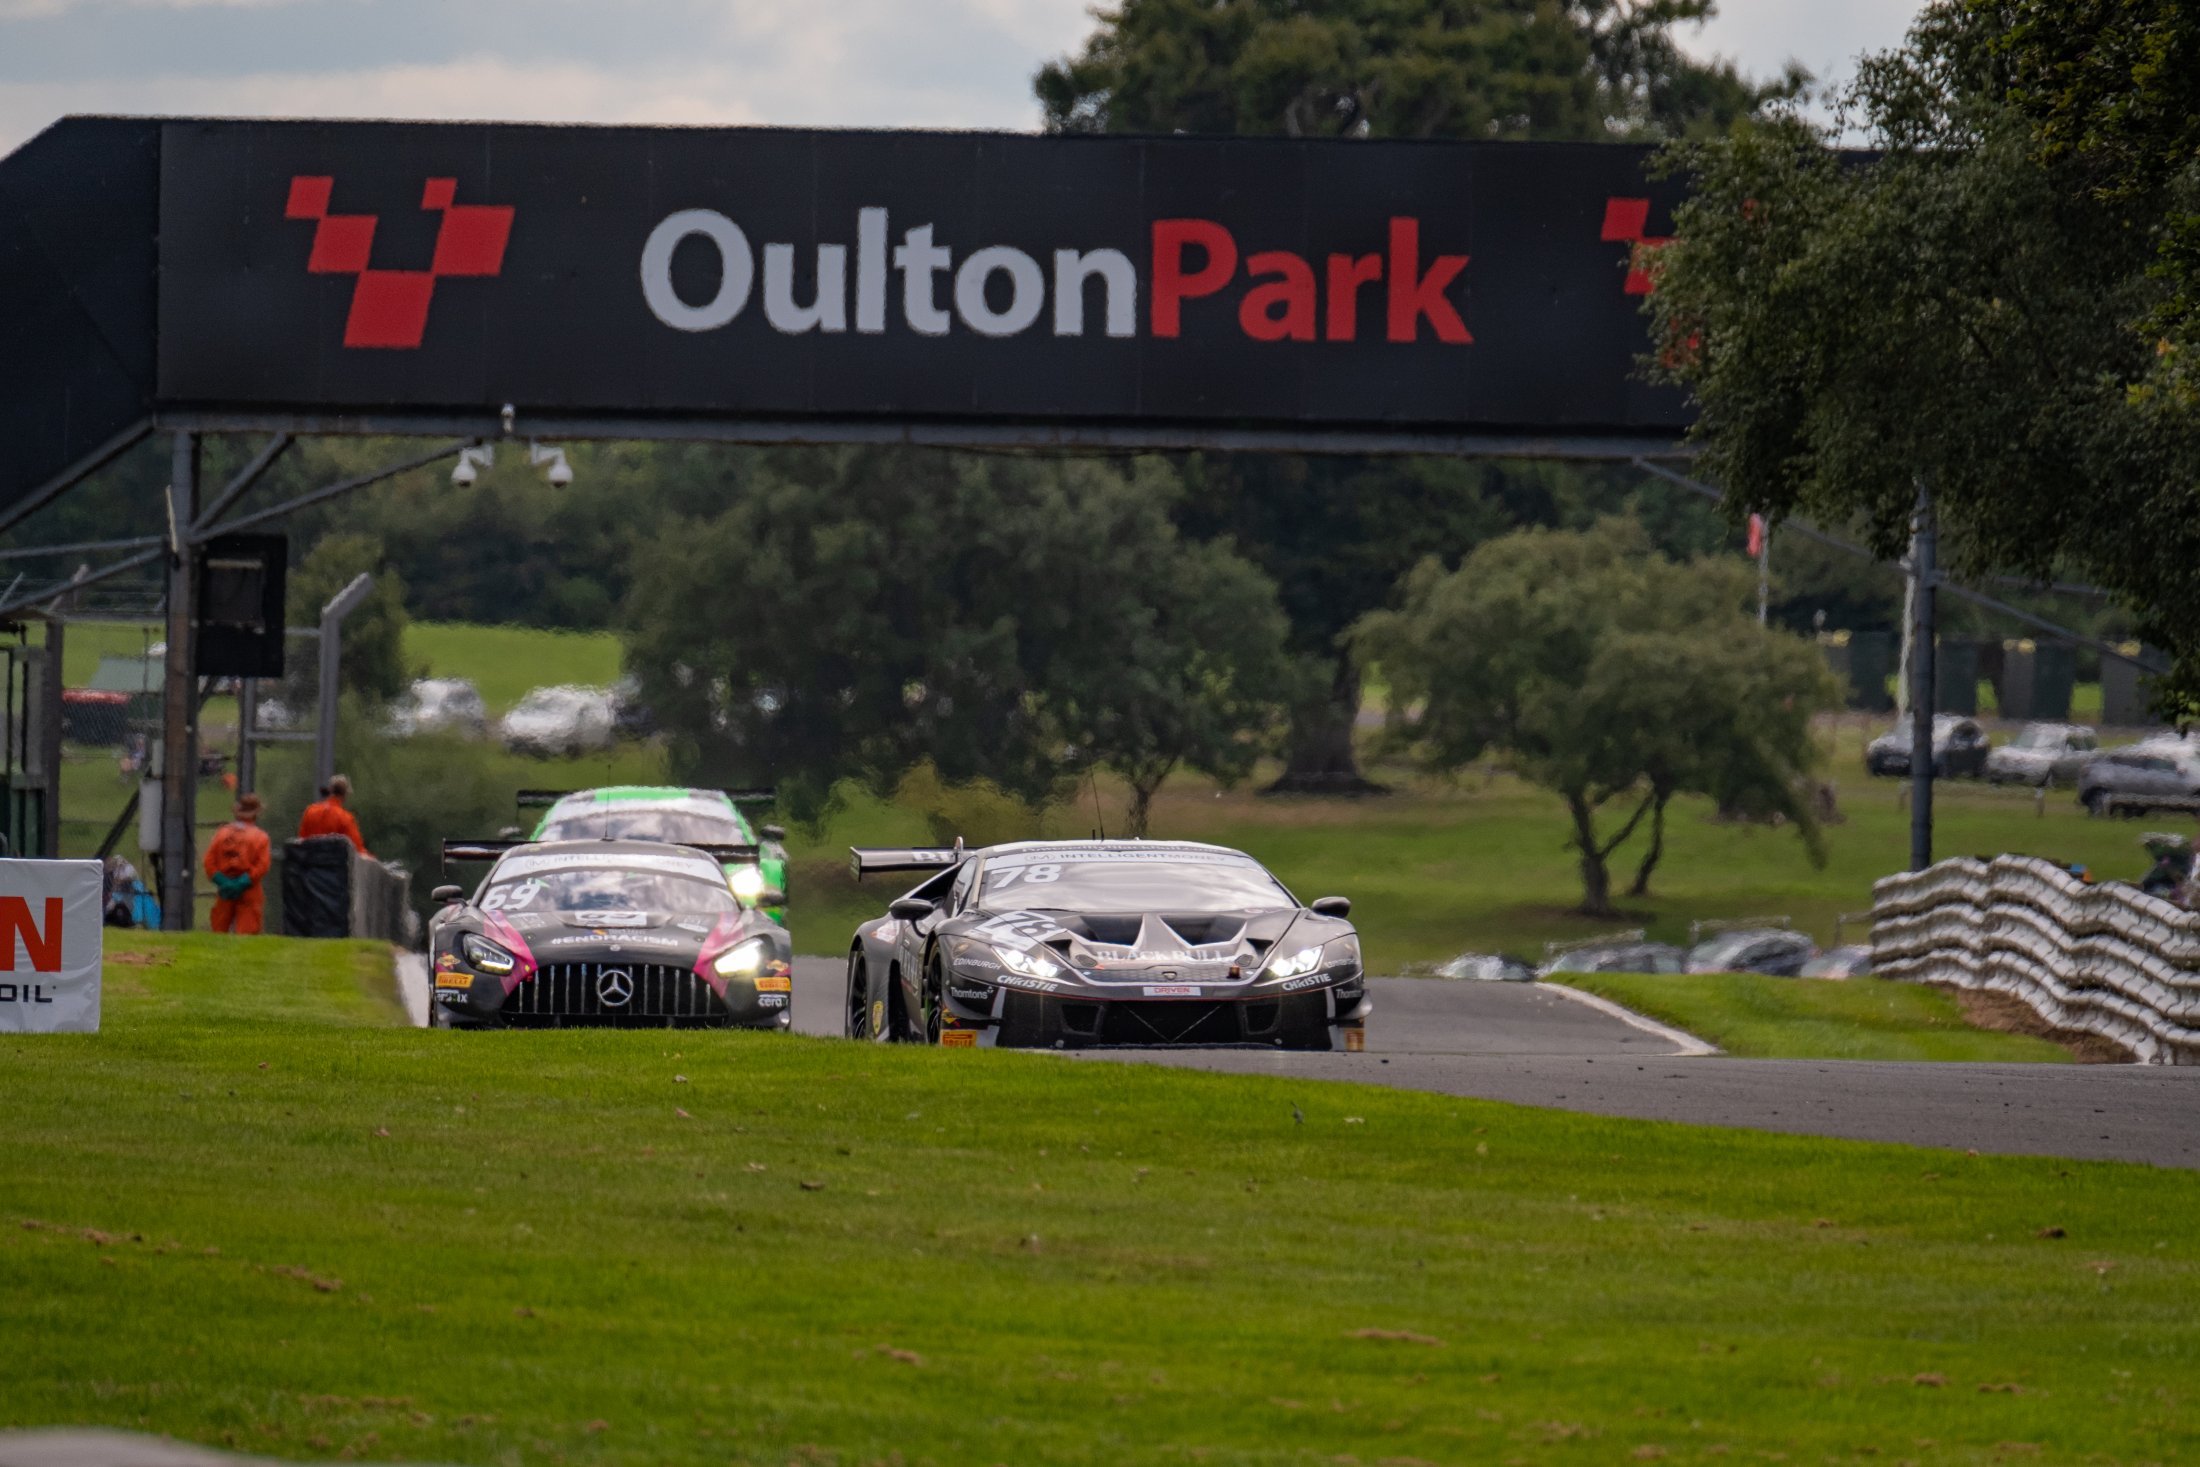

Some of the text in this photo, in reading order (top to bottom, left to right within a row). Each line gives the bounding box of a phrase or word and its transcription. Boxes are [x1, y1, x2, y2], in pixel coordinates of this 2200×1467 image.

[991, 864, 1062, 889] 78
[480, 882, 541, 911] 69
[984, 912, 1062, 938] 78
[953, 957, 1002, 970] EDINBURGH
[997, 975, 1058, 992] CHRISTIE
[1154, 986, 1191, 994] DRIVEN
[1282, 973, 1332, 991] CHRISTIE
[0, 984, 53, 1003] OIL
